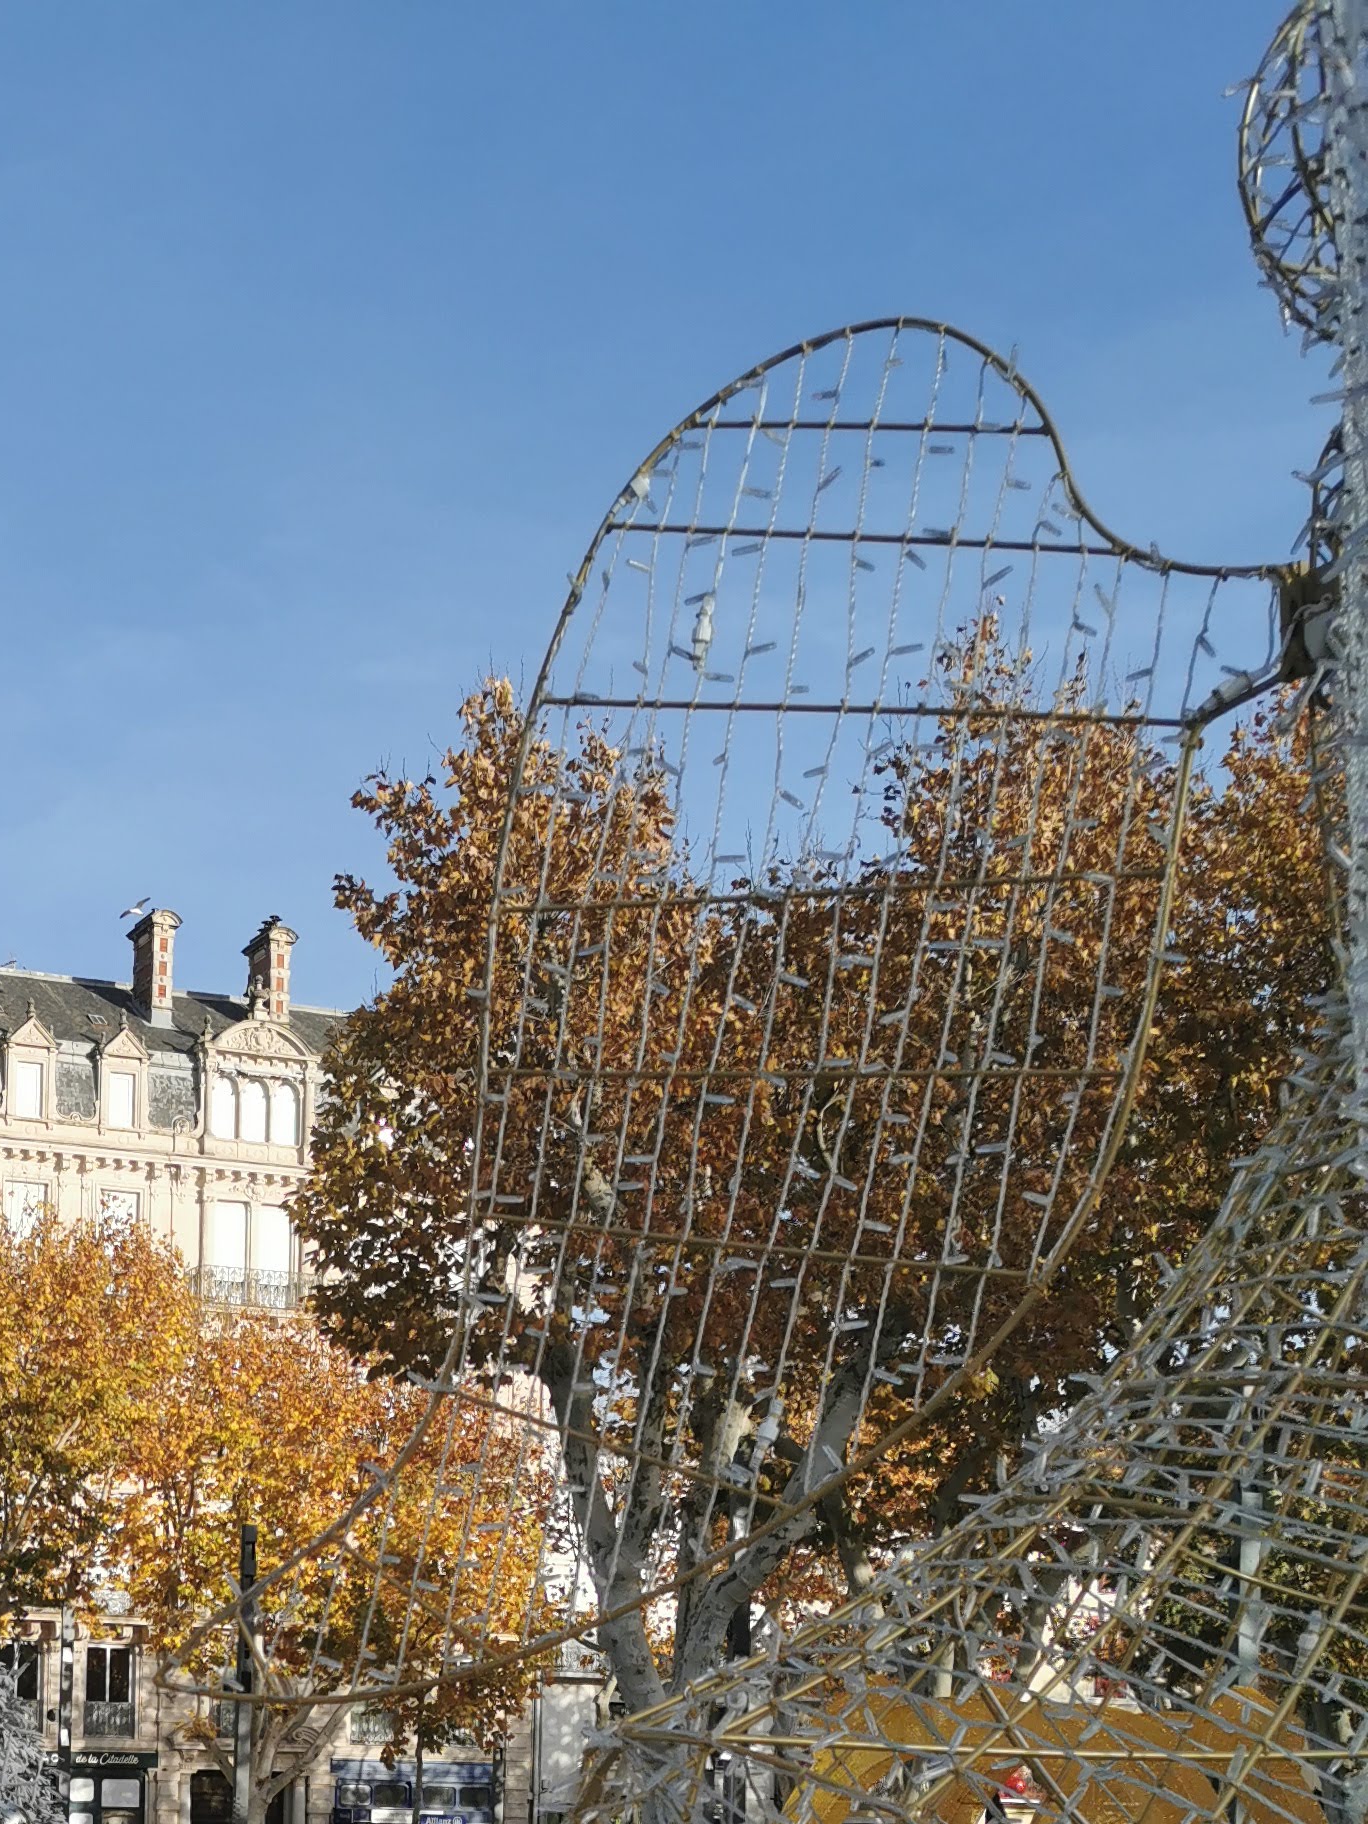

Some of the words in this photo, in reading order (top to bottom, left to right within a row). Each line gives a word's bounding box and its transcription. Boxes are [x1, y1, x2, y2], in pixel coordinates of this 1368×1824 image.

[76, 1754, 87, 1763] de
[88, 1754, 98, 1764] la
[100, 1753, 139, 1765] Citadelle
[425, 1816, 452, 1824] Allianz
